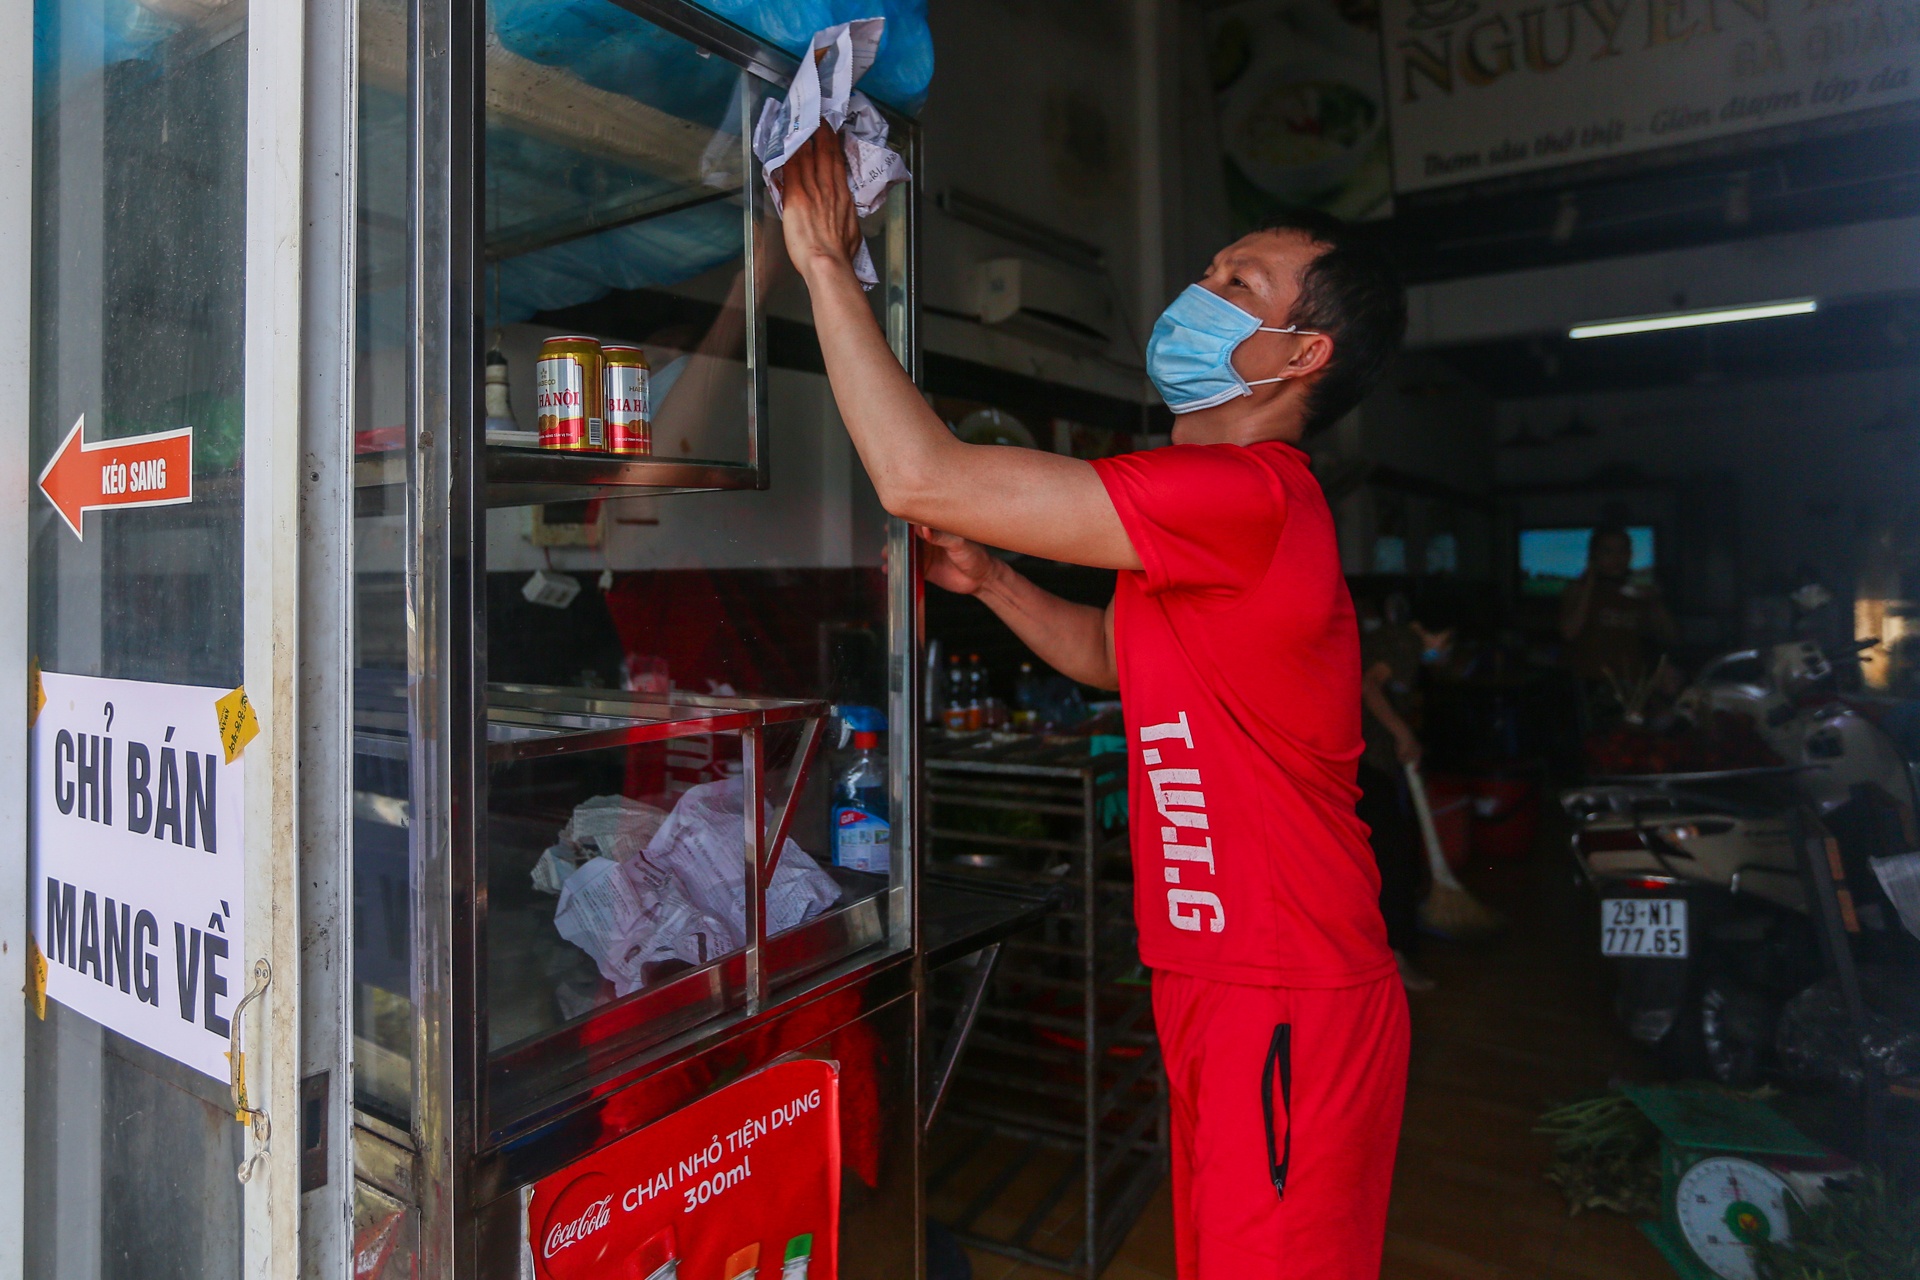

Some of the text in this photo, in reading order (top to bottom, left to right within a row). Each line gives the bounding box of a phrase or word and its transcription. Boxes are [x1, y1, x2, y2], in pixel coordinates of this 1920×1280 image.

[1868, 65, 1911, 93] da
[538, 387, 580, 409] HÀ NỘI
[608, 398, 632, 412] BIA
[102, 458, 167, 495] KÉO SANG
[54, 701, 217, 855] CHỈ BÁN
[1140, 711, 1226, 933] T.W.T.G
[1612, 901, 1673, 925] 29-N1
[46, 876, 160, 1008] MANG
[174, 899, 231, 1040] VỀ
[1605, 927, 1682, 953] 777.65
[622, 1089, 821, 1212] CHAI NHỎ TIỆN DỤNG
[683, 1155, 751, 1213] 300ml
[544, 1193, 615, 1259] Coca-Cola
